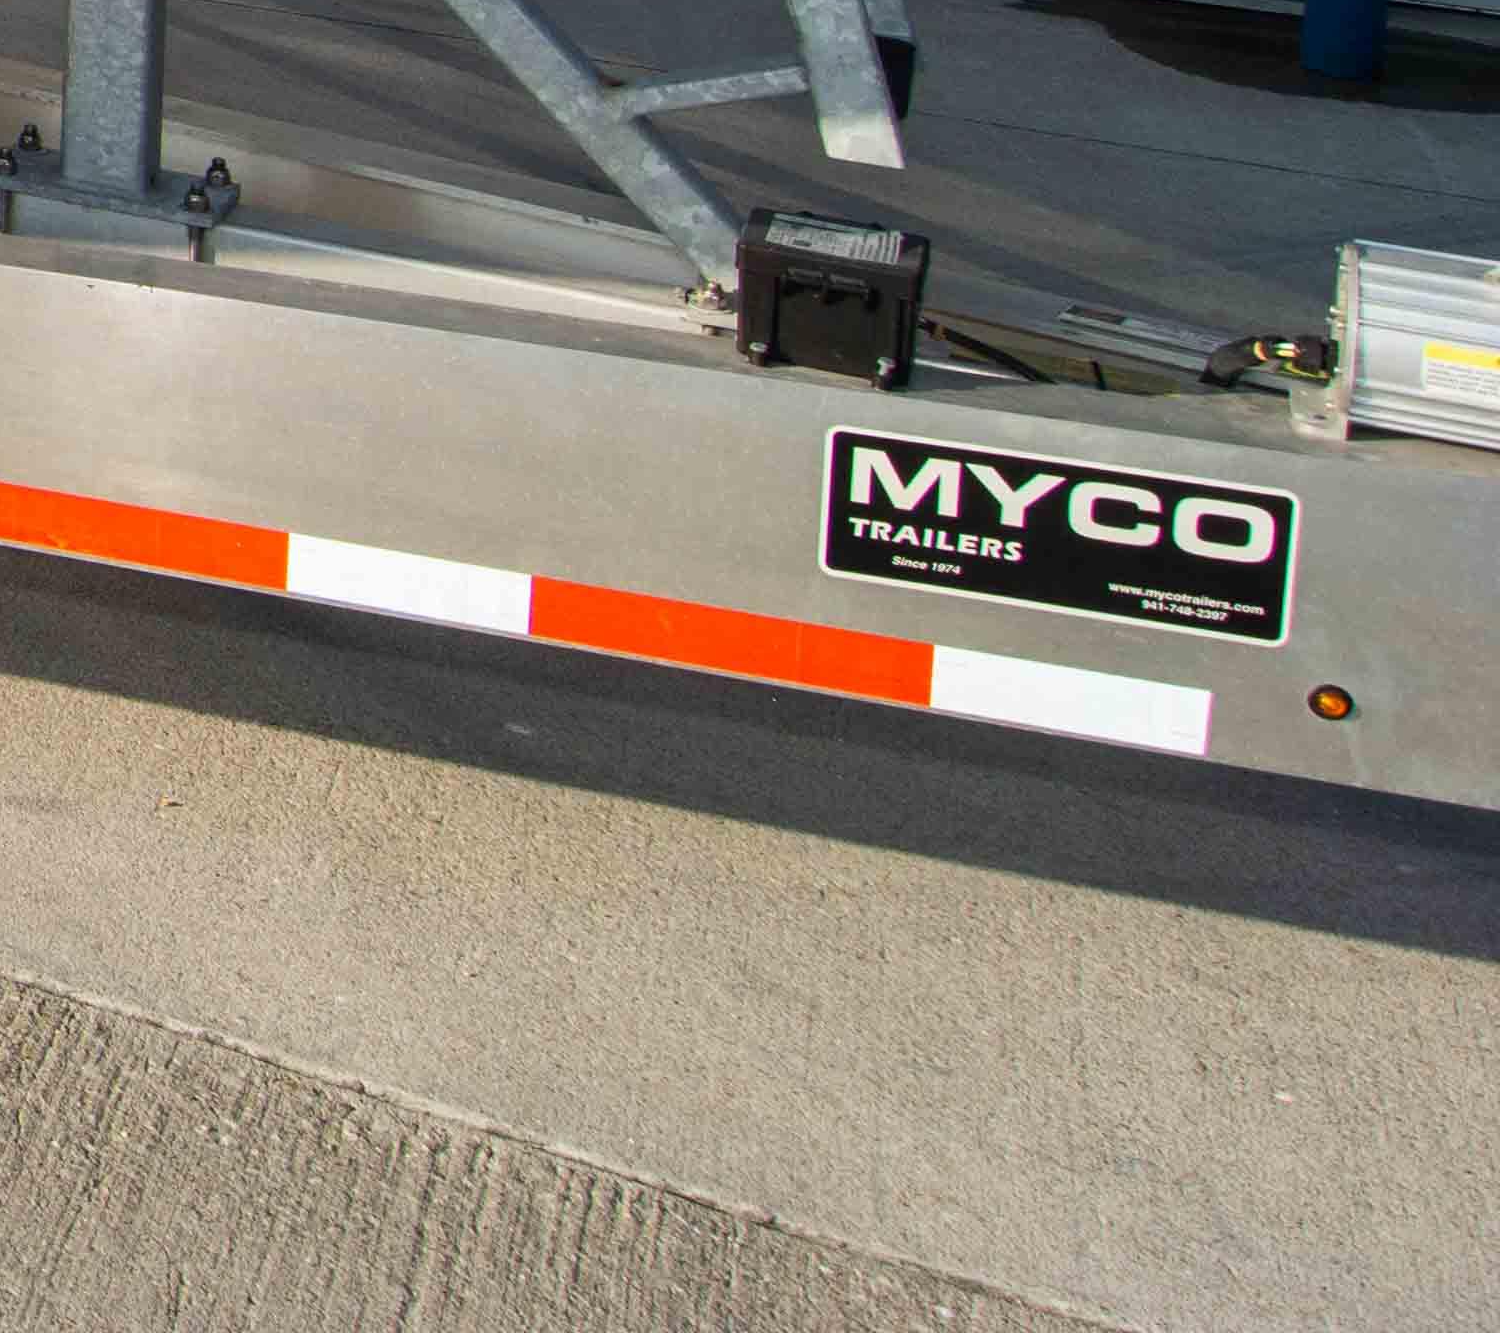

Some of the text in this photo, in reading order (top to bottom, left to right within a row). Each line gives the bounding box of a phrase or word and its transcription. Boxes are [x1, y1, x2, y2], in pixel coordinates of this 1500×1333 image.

[849, 445, 1276, 564] MYCO
[847, 516, 1025, 563] TRAILERS
[891, 554, 962, 576] Since 1974
[1108, 581, 1265, 616] www.mycotrailers.com
